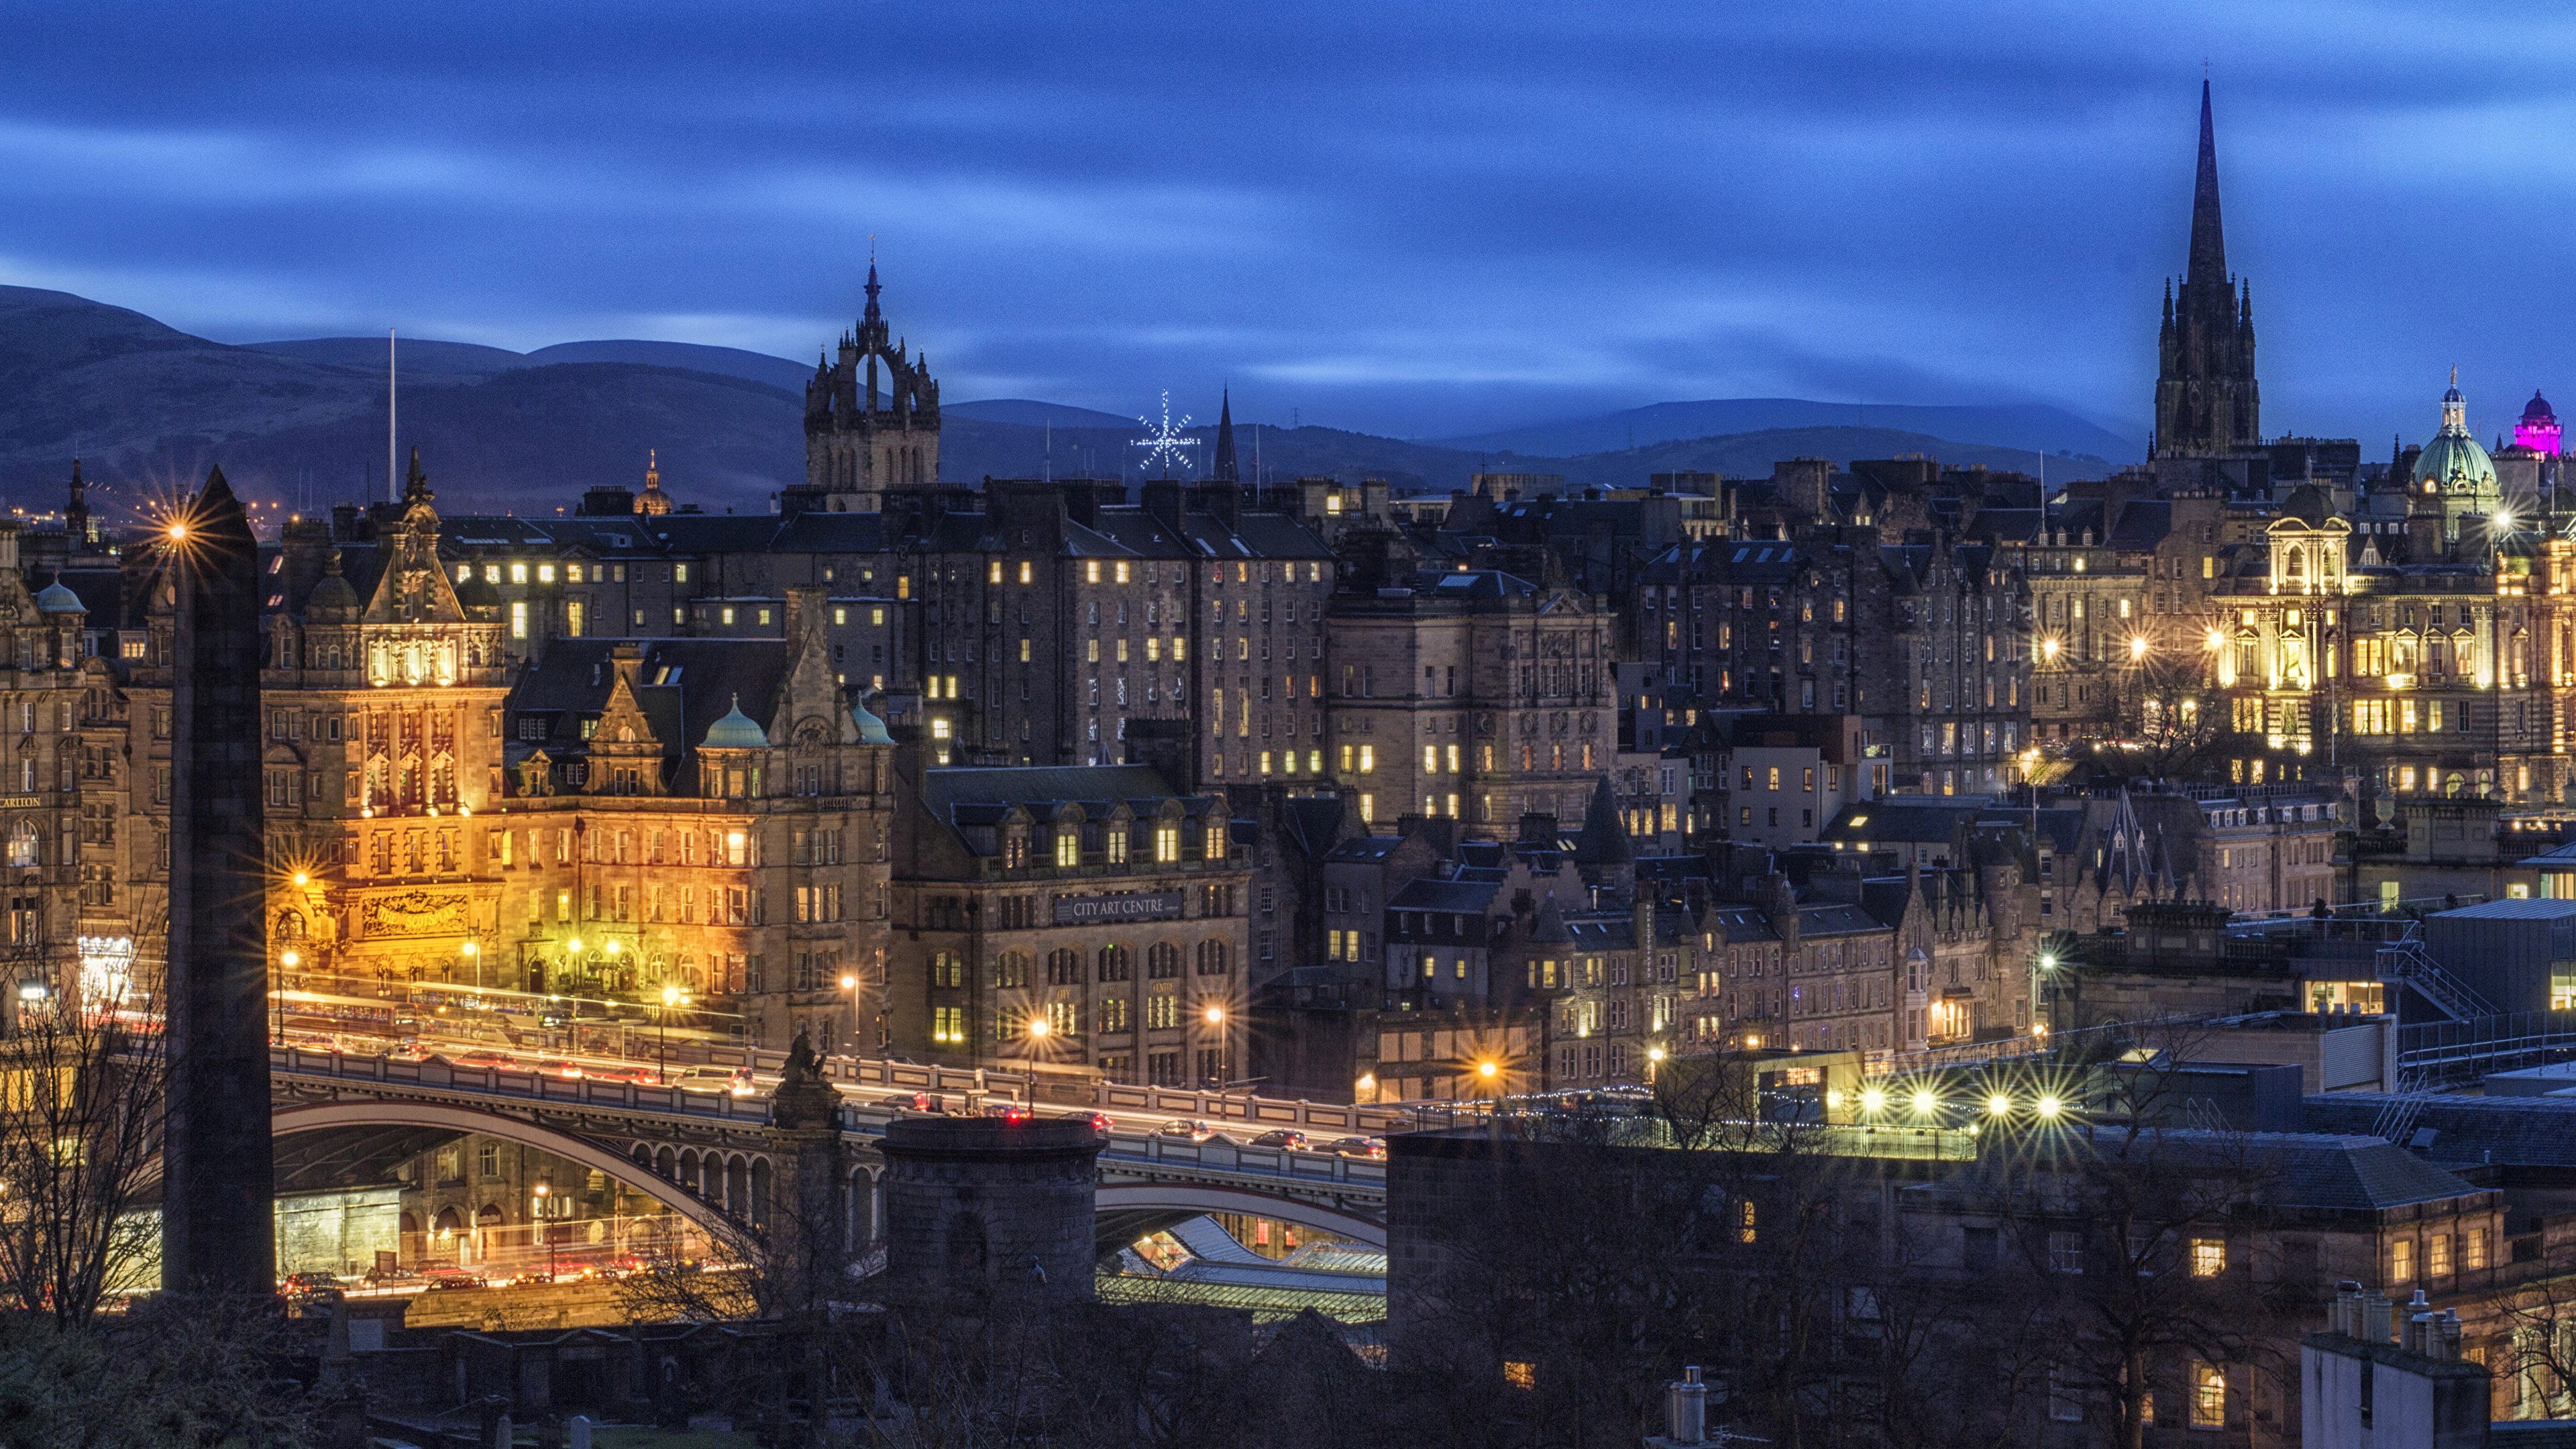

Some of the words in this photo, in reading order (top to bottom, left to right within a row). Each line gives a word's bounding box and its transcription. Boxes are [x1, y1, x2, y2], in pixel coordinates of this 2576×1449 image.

[378, 907, 397, 924] THE
[406, 904, 456, 928] SCOTSMAN
[1074, 903, 1098, 916] CITY
[1100, 901, 1120, 914] ART
[1122, 899, 1163, 913] CENTRE
